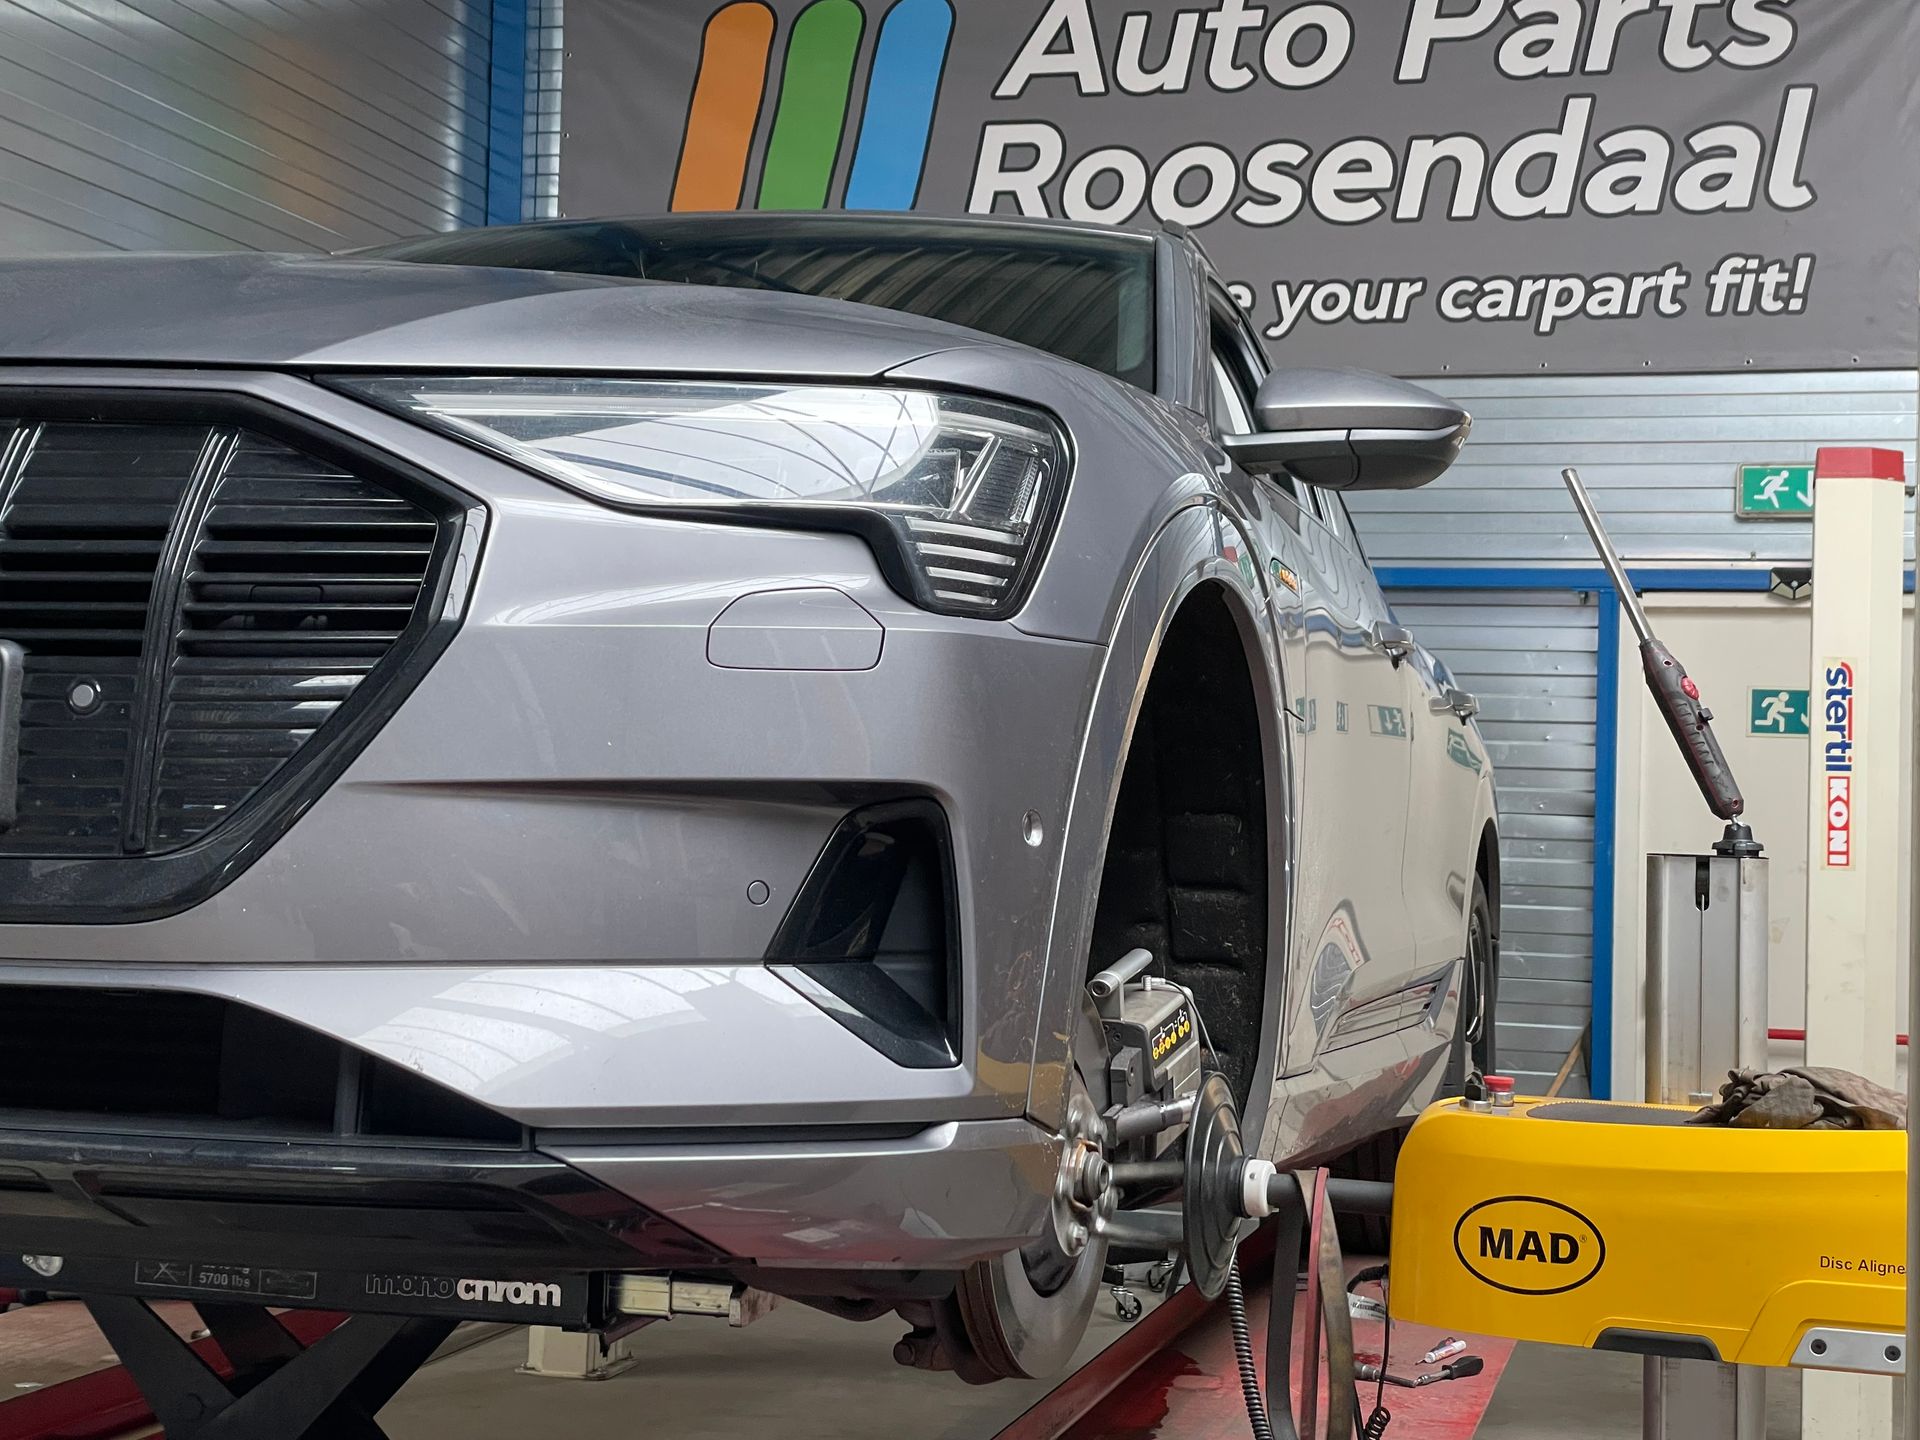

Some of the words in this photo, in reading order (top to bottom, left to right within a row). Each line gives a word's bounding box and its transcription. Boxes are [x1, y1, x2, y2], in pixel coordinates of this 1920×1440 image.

[995, 0, 1351, 96] Auto
[1398, 0, 1793, 80] Parts
[967, 87, 1814, 227] Roosendaal
[1266, 281, 1423, 337] your
[1440, 266, 1687, 332] carpart
[1710, 257, 1811, 313] fit!
[1826, 662, 1853, 771] stertil
[1828, 777, 1850, 866] KONI
[199, 1272, 229, 1286] 5700
[231, 1275, 251, 1288] lbs
[1820, 1255, 1853, 1271] Disc
[1857, 1259, 1906, 1277] Aligne
